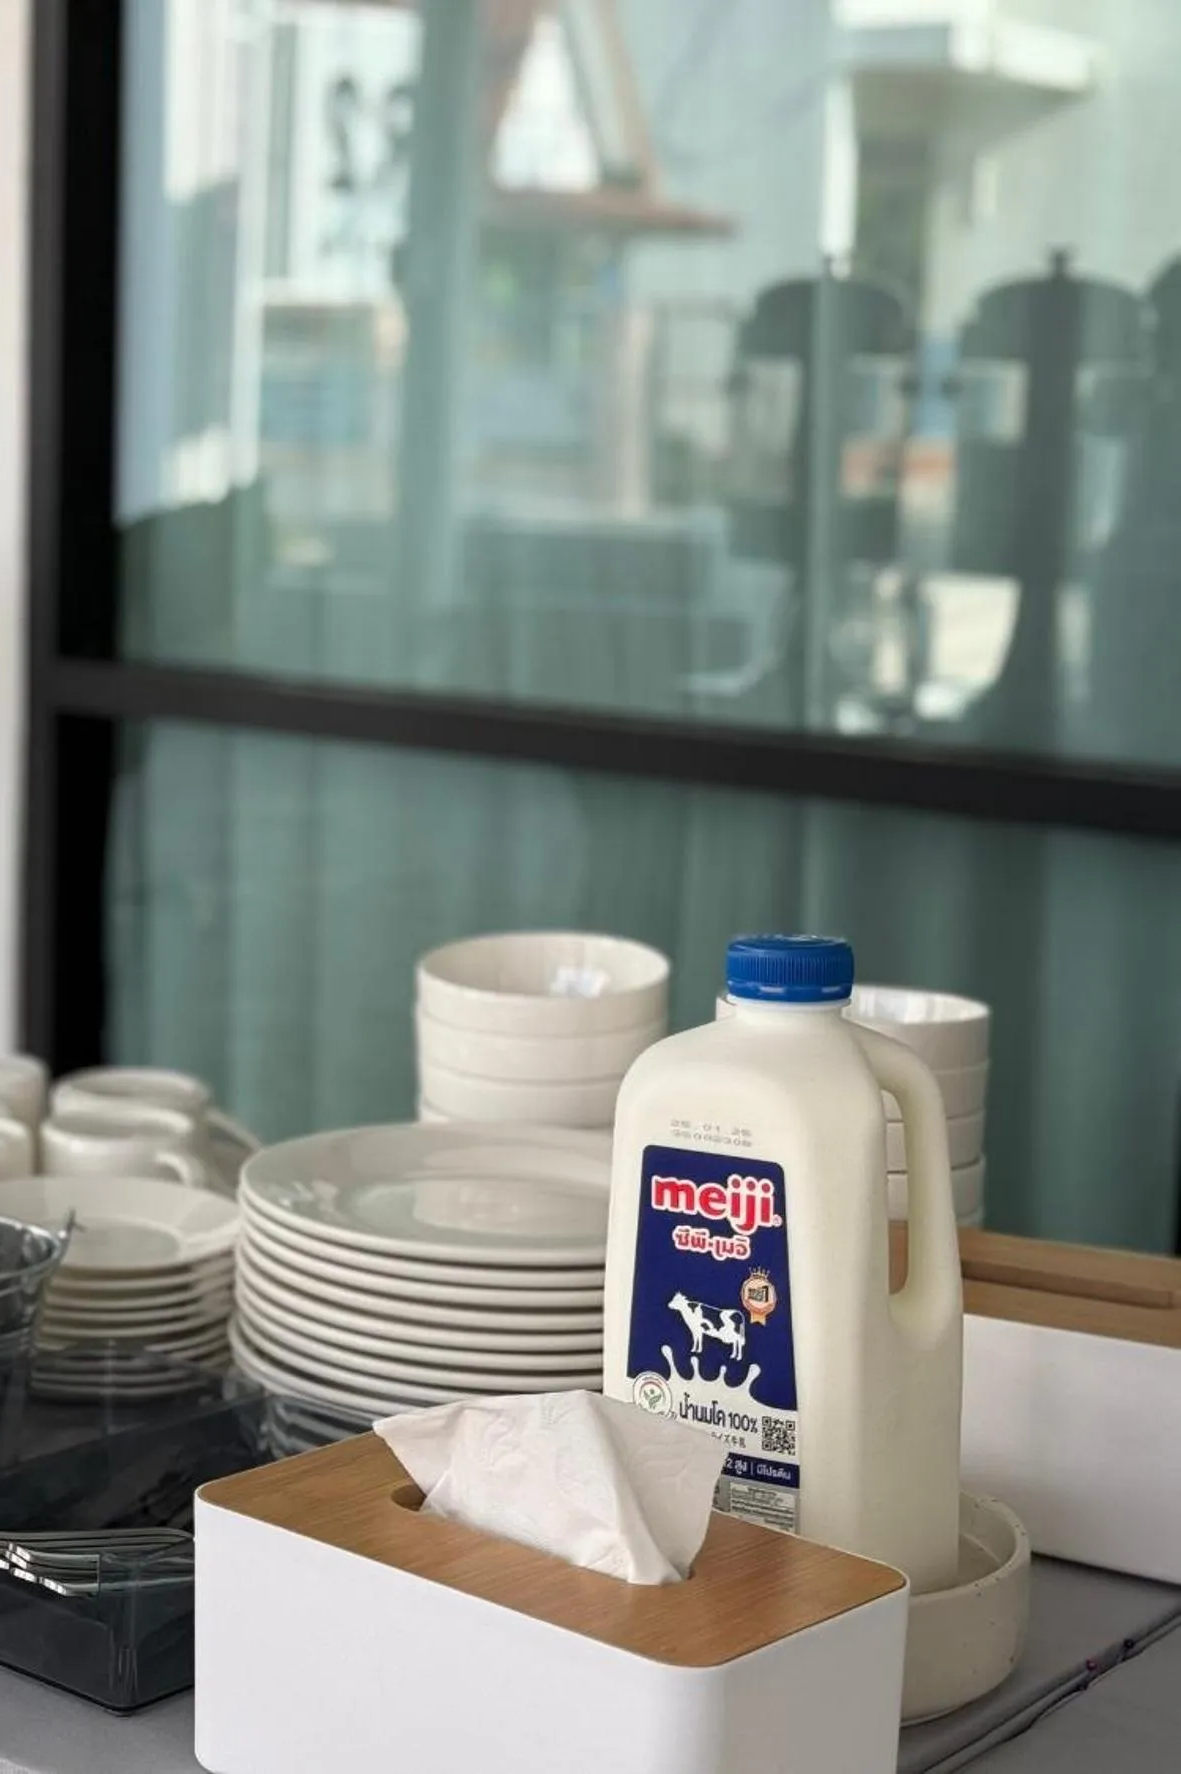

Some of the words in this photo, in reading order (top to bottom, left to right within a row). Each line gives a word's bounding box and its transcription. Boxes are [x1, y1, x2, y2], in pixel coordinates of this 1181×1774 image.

[651, 1174, 775, 1234] meiji
[679, 1392, 727, 1428] น้ำนมโค
[727, 1412, 758, 1433] 100%
